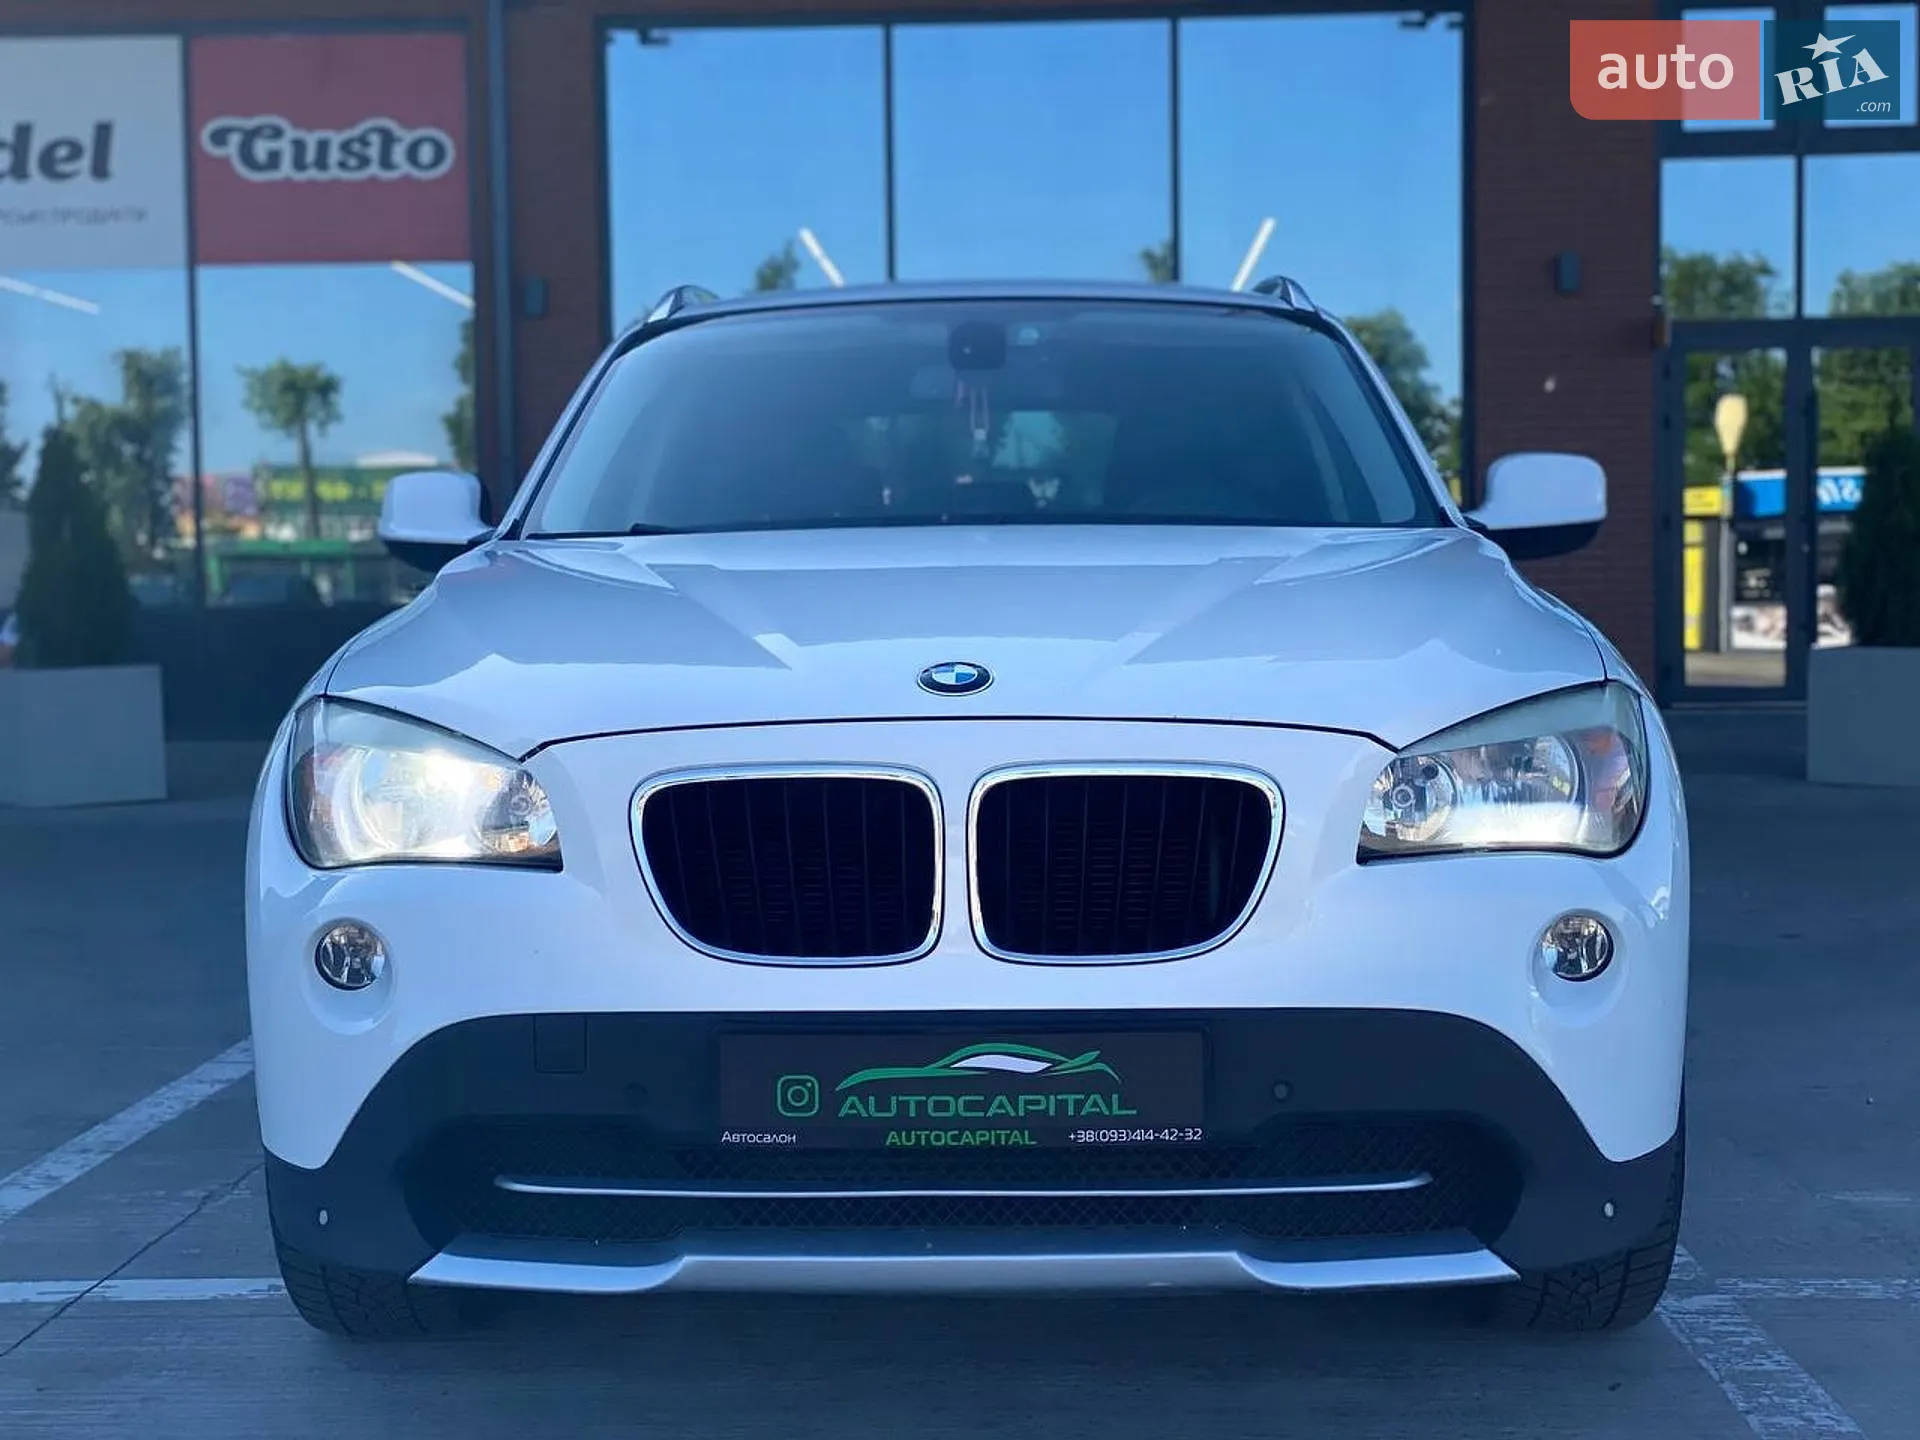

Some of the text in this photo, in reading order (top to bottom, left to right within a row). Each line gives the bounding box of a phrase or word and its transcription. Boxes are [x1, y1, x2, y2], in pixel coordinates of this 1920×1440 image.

[206, 120, 449, 175] Gusto
[838, 1094, 1137, 1118] AUTOCAPITAL
[720, 1131, 797, 1146] Автосалон
[885, 1130, 1037, 1147] AUTOCAPITAL
[1068, 1128, 1203, 1143] +38(093)414-42-32
